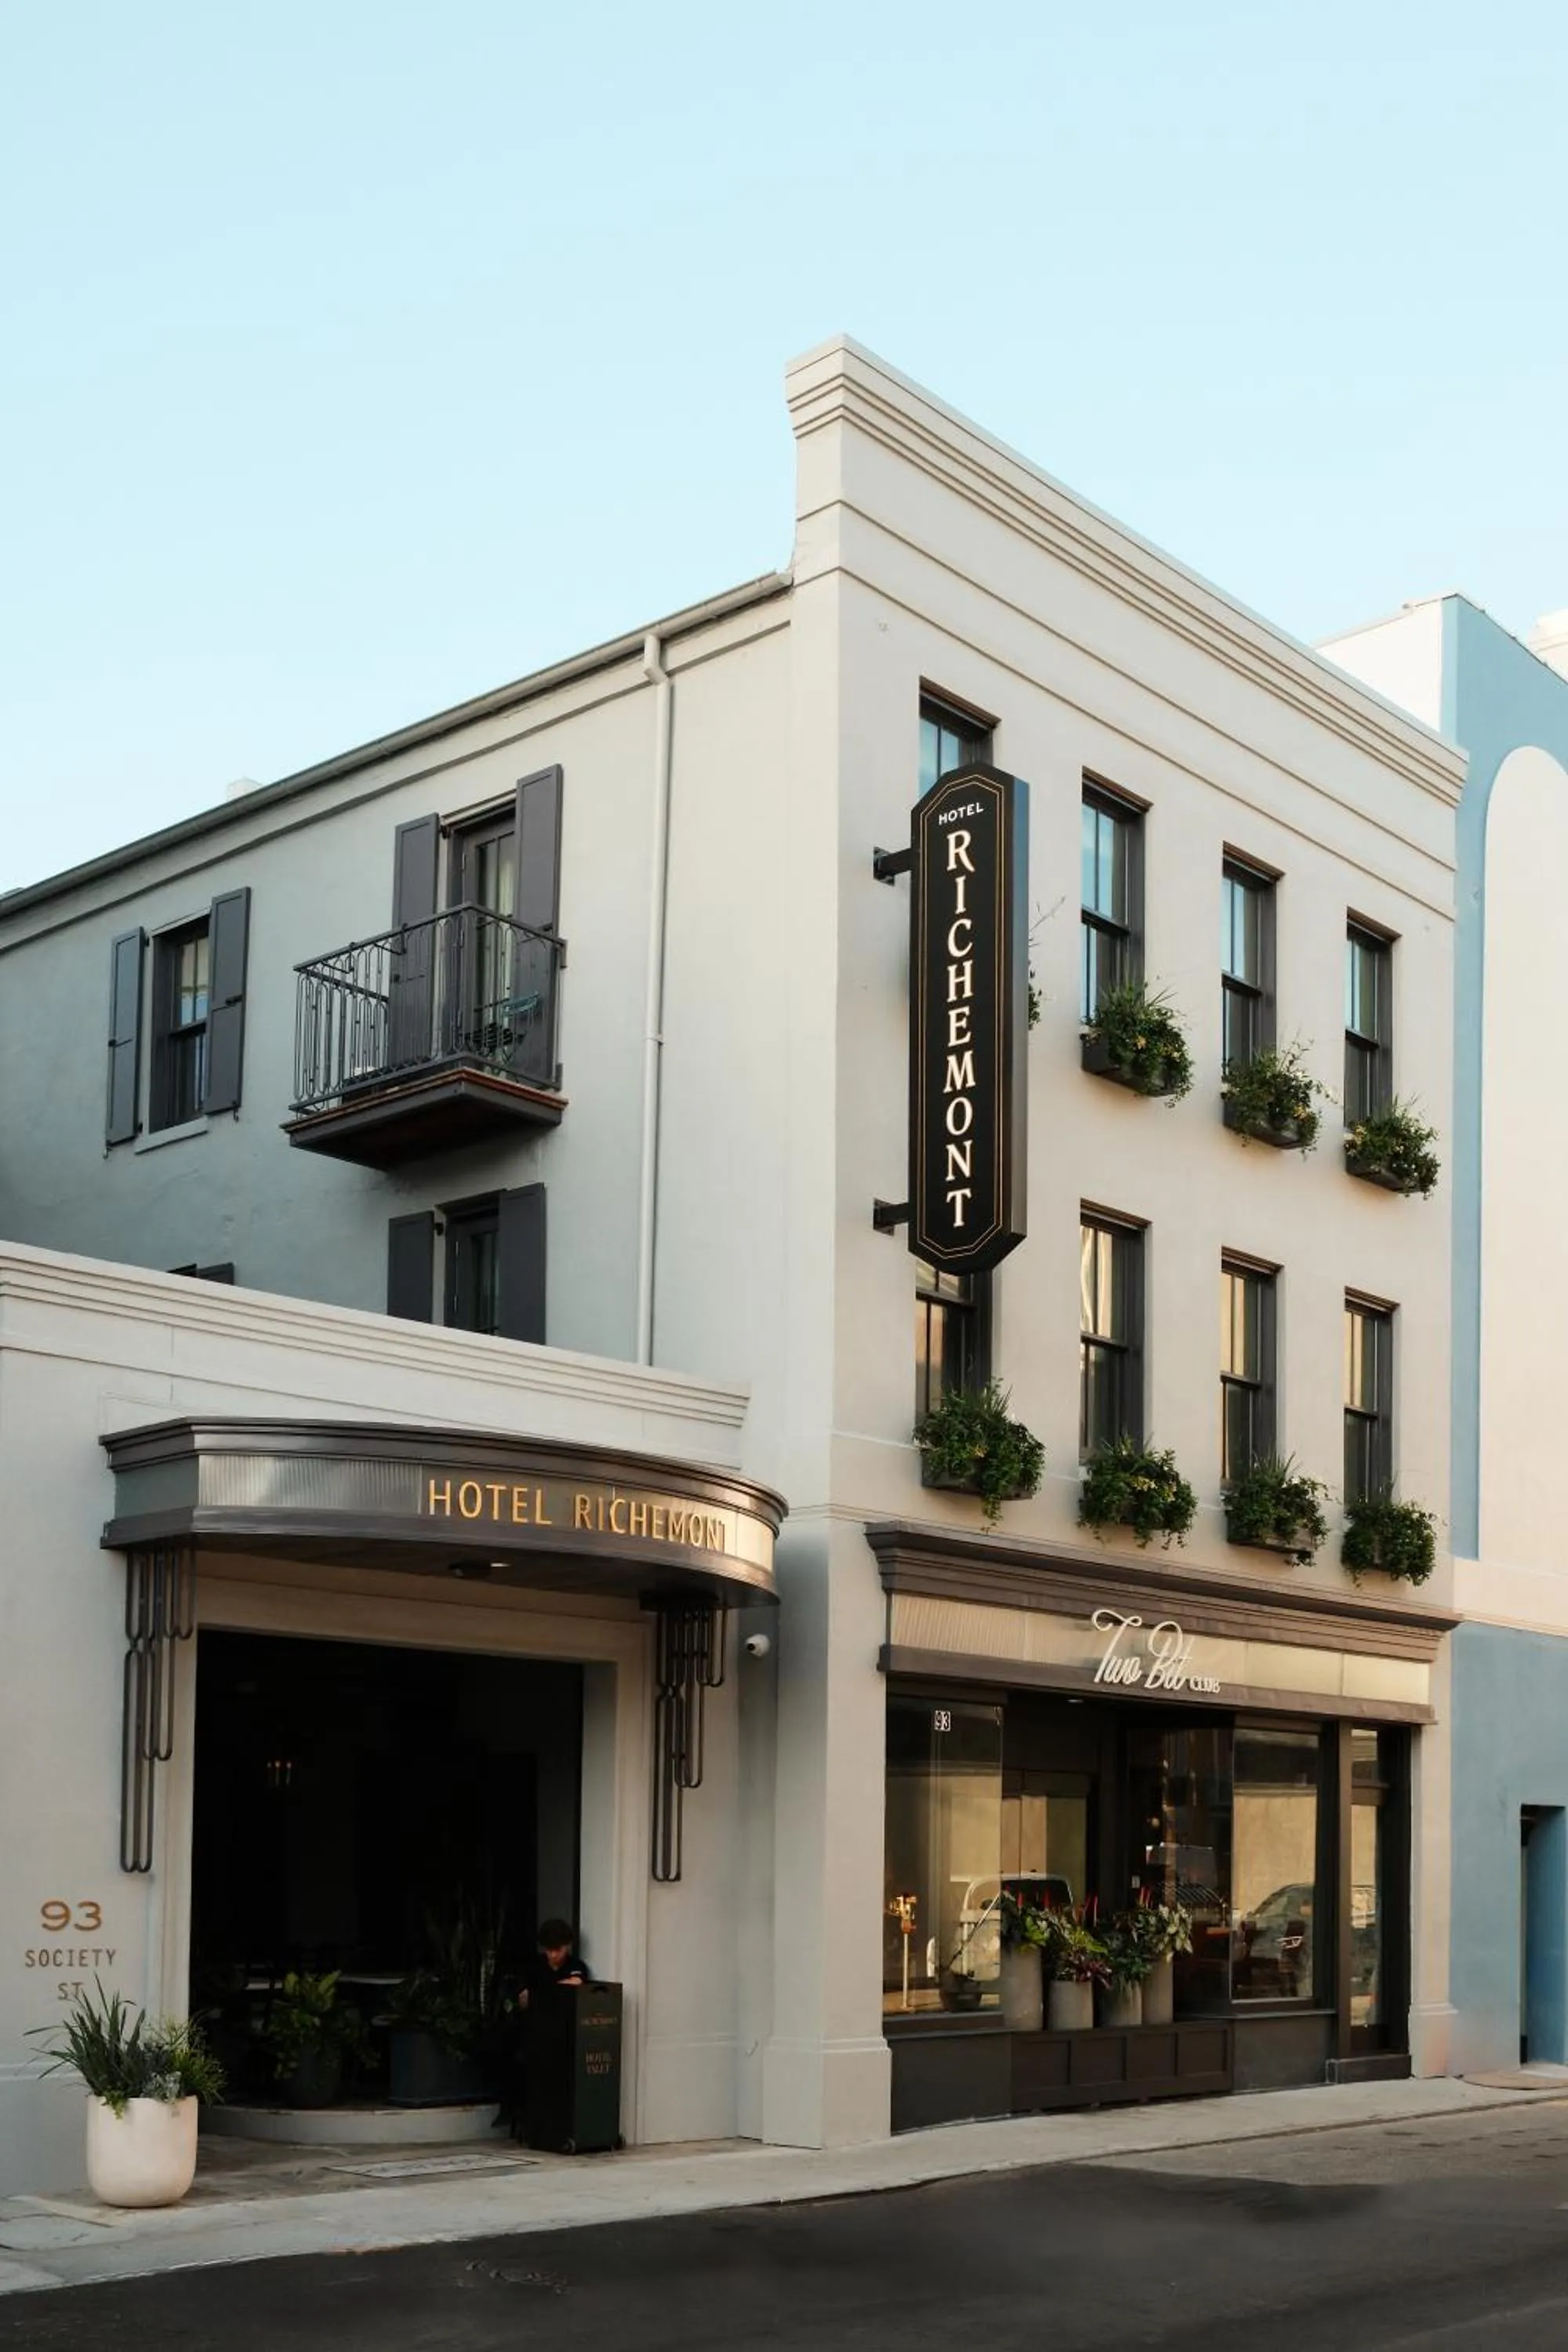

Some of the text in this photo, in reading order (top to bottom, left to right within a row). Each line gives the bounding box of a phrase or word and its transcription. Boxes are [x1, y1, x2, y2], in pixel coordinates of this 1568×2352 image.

[938, 802, 984, 826] HOTEL
[943, 829, 976, 1228] RICHEMONT
[429, 1479, 726, 1553] HOTEL RICHEMONT
[1091, 1610, 1142, 1684] Two
[1144, 1621, 1195, 1690] Bit
[935, 1711, 951, 1731] 93
[41, 1900, 102, 1931] 93
[25, 1949, 116, 1967] SOCIETY
[58, 1982, 83, 2000] ST
